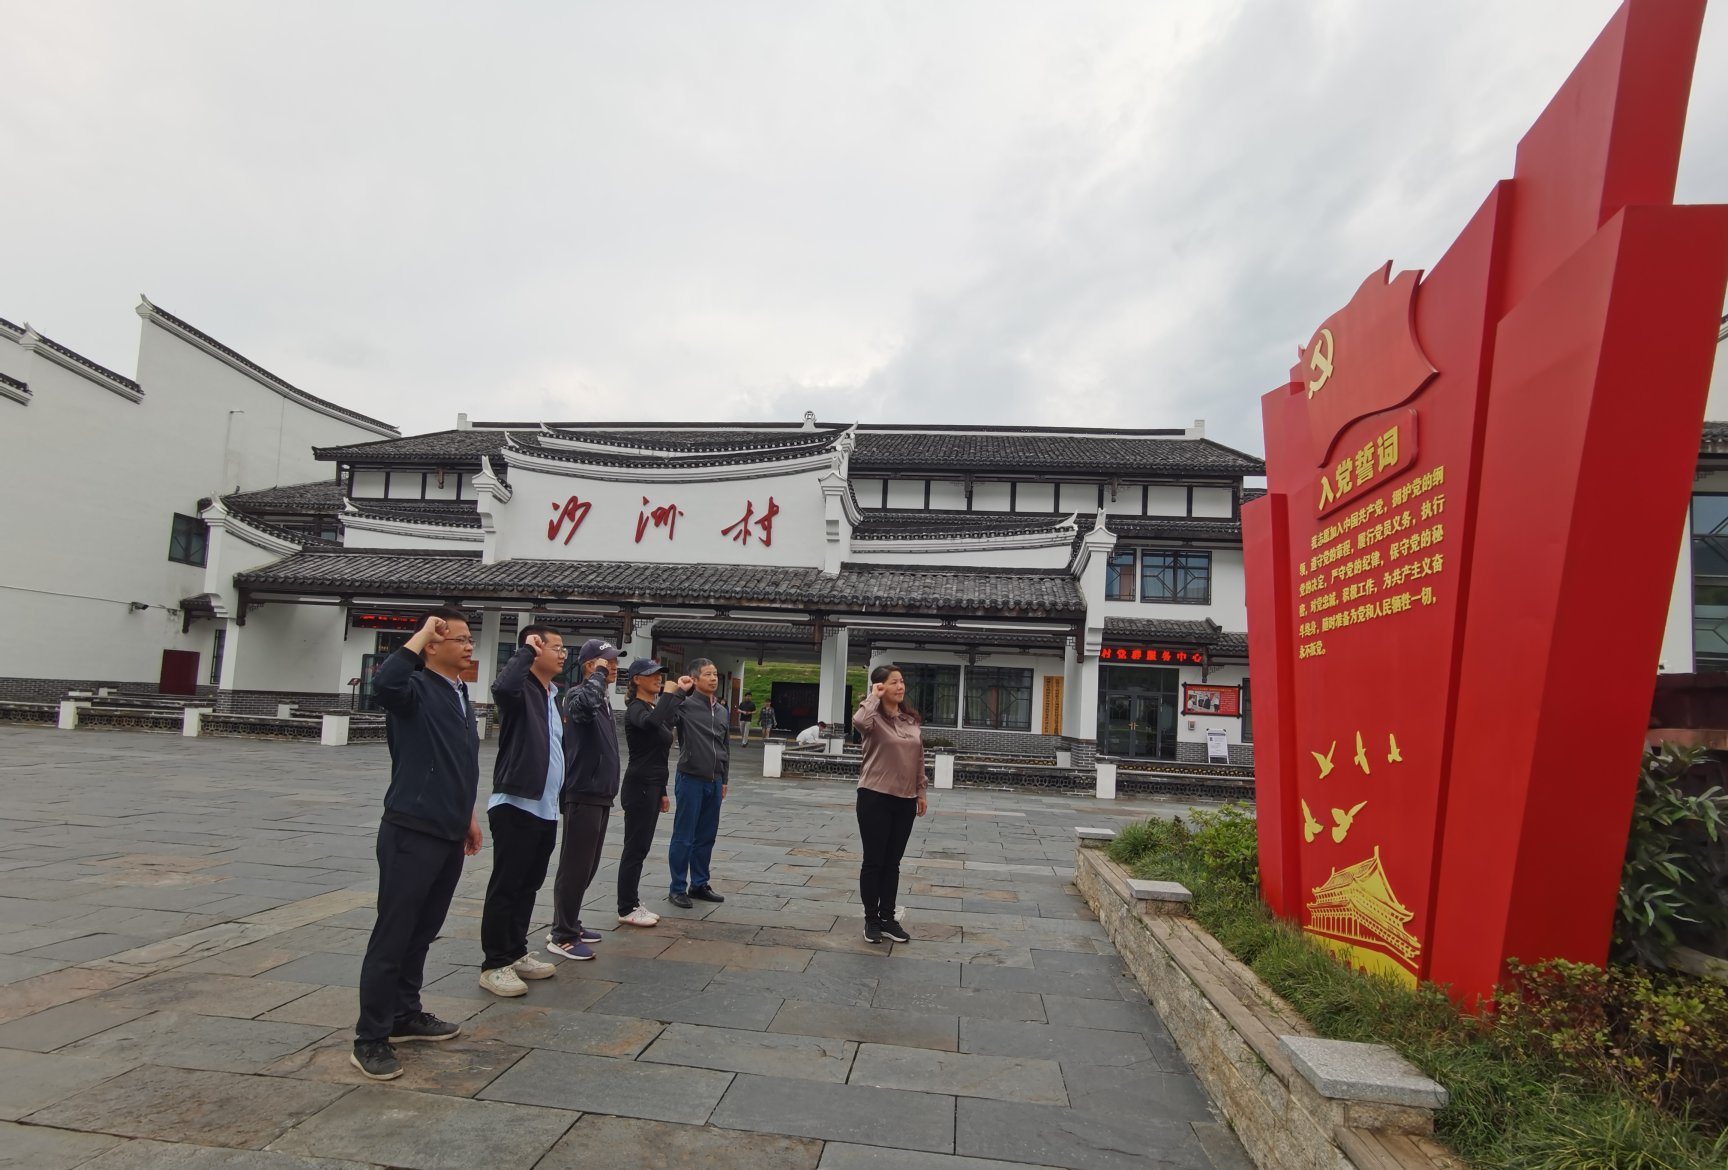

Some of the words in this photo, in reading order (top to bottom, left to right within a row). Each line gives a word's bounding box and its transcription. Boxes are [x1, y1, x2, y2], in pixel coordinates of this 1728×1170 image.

[1318, 426, 1400, 511] 入党誓词
[547, 495, 780, 546] 沙洲村
